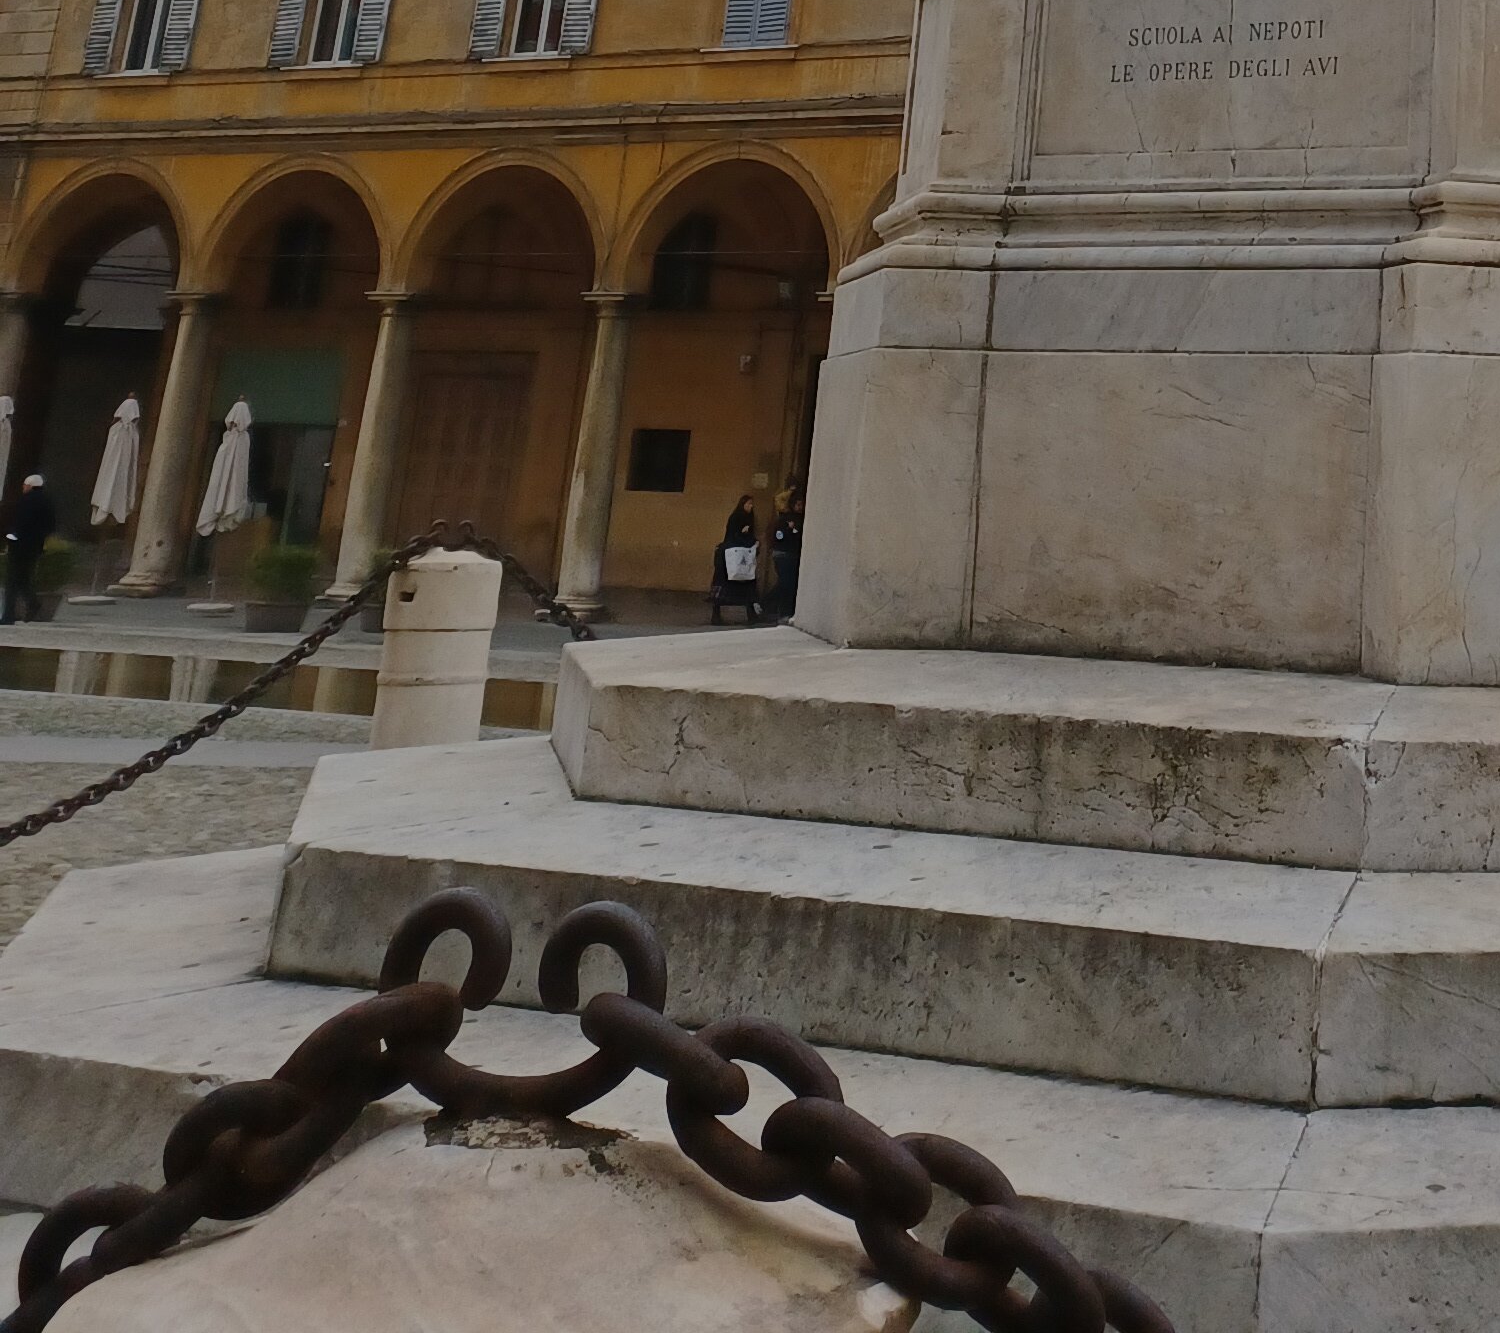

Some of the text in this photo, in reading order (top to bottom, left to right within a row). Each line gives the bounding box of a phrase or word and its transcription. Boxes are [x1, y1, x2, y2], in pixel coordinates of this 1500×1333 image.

[1127, 20, 1324, 47] SCUOLA AI NEPOTI
[1110, 56, 1339, 83] LE OPERE DEGLI AVI
